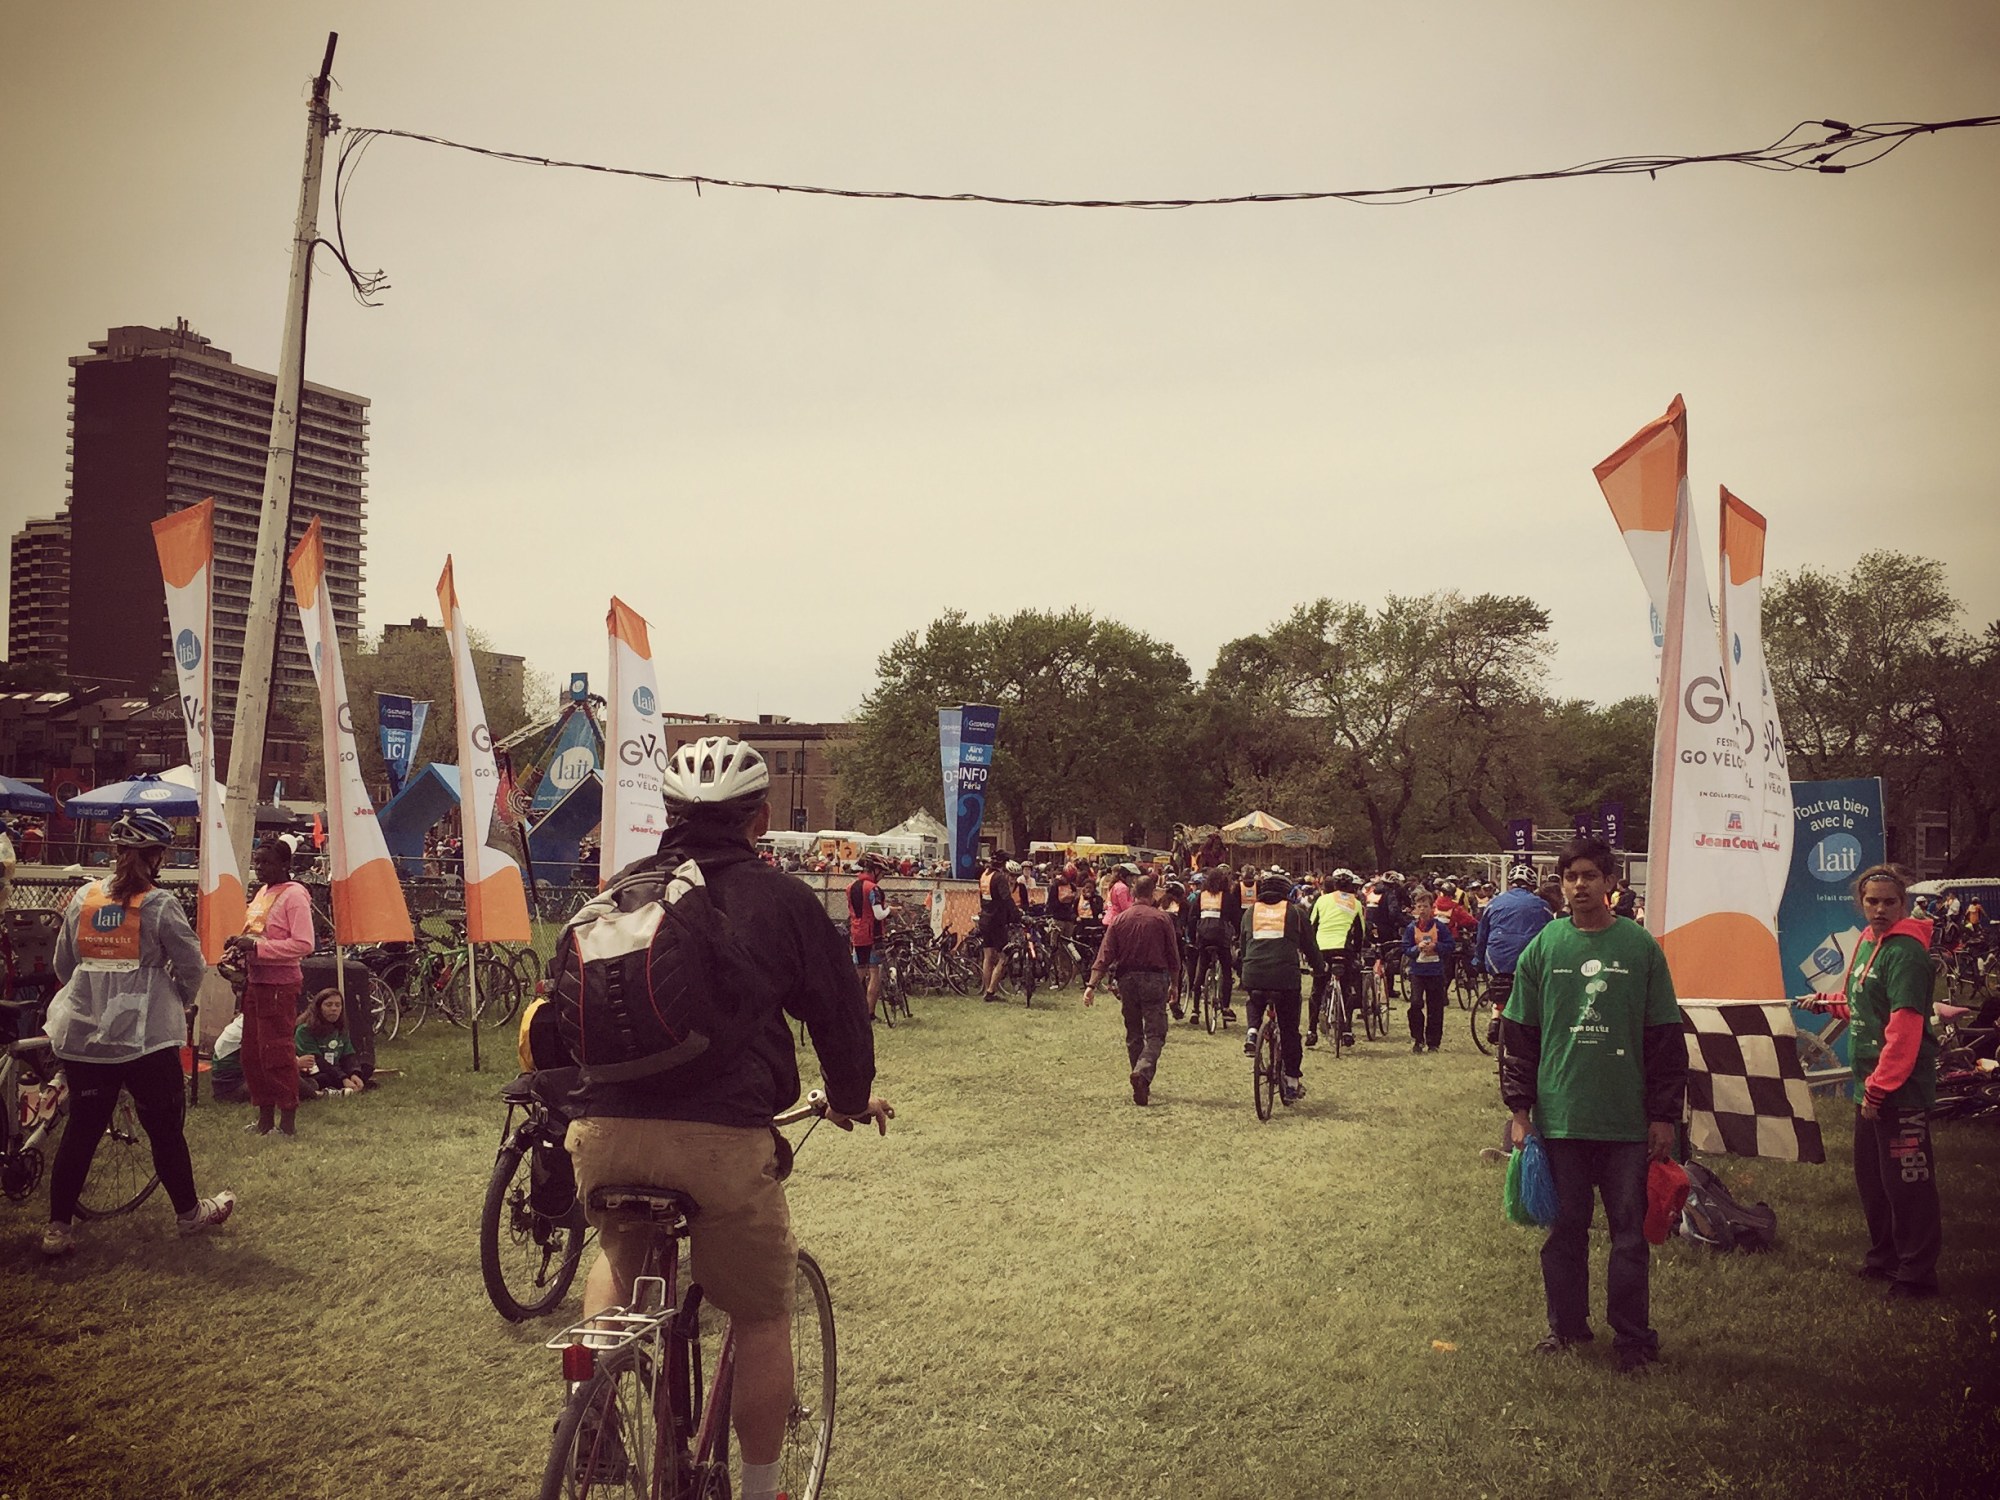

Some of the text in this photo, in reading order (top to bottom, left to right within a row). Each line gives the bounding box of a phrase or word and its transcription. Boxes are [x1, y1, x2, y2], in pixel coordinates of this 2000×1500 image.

[387, 743, 406, 759] ICI
[968, 746, 984, 754] Aire
[1681, 750, 1707, 765] GO
[474, 768, 490, 777] GO
[558, 754, 589, 780] lait
[960, 767, 987, 781] INFO
[619, 780, 658, 792] GO VÉLO
[963, 781, 981, 791] Féria
[76, 808, 109, 816] lelait.com
[1793, 800, 1825, 820] Tout
[1825, 799, 1841, 811] va
[1843, 796, 1869, 818] bien
[1810, 813, 1854, 832] avec le
[1695, 834, 1731, 848] Jean
[1817, 842, 1857, 872] lait
[96, 908, 122, 927] lait
